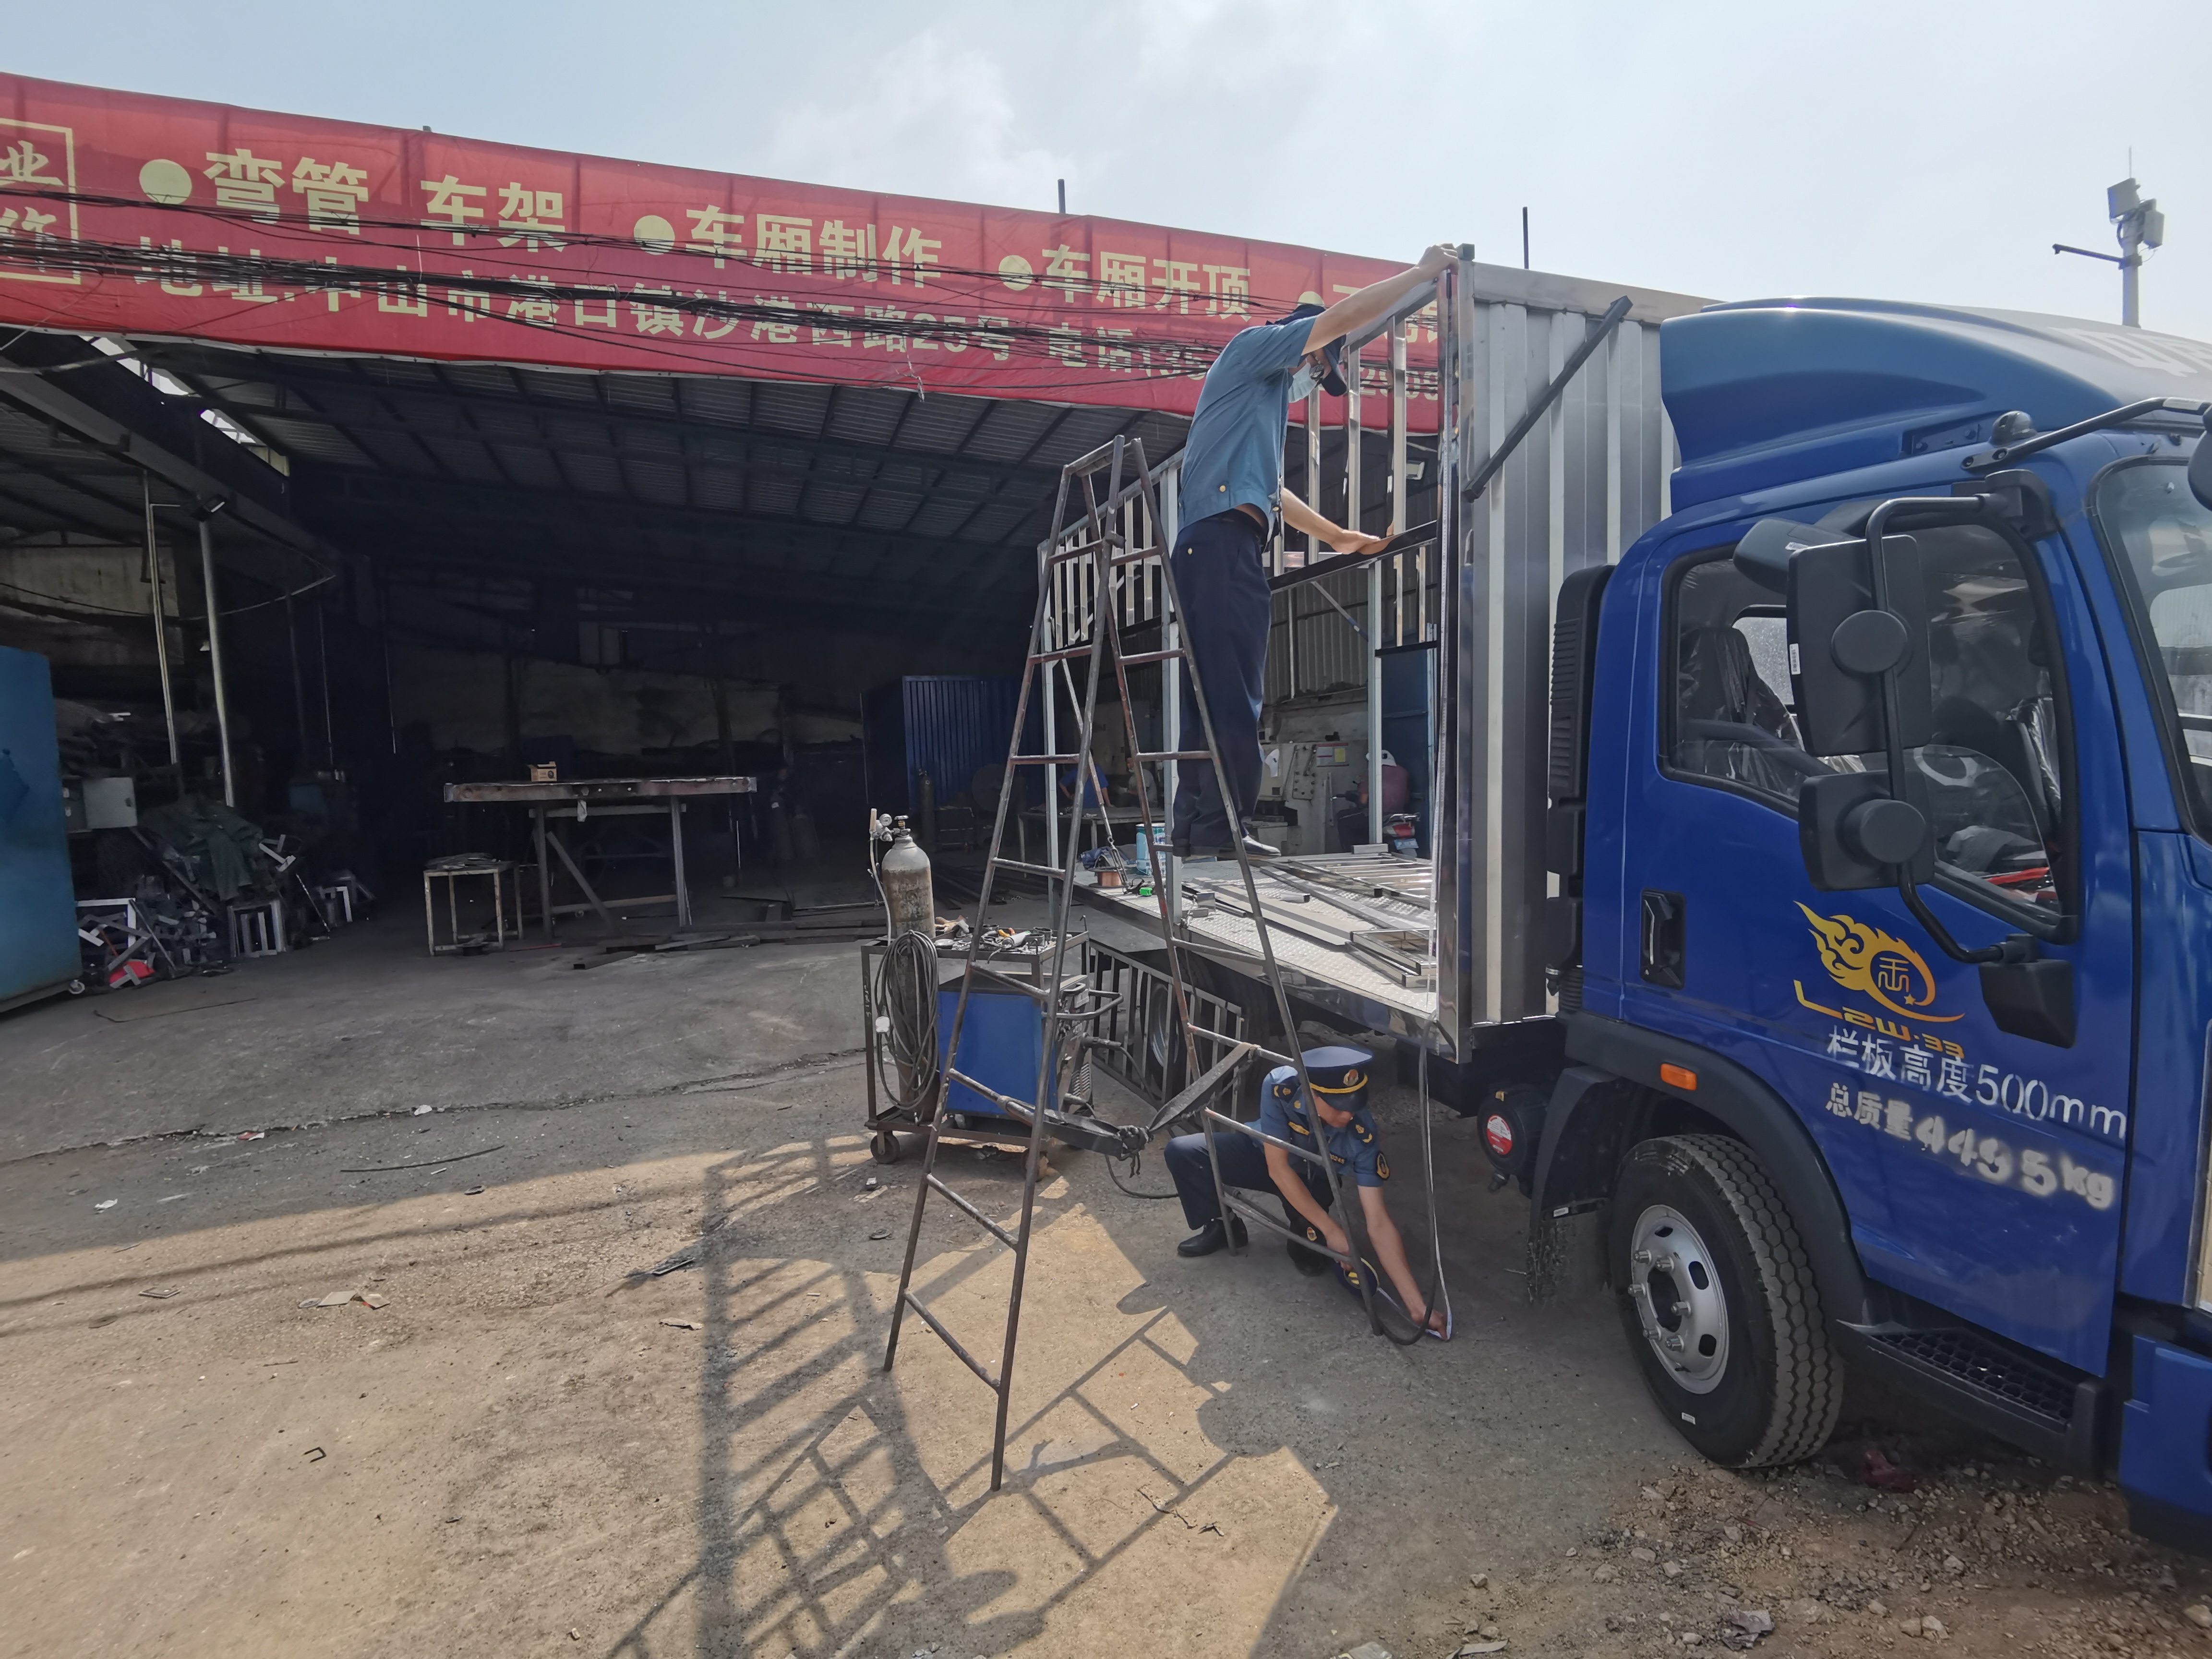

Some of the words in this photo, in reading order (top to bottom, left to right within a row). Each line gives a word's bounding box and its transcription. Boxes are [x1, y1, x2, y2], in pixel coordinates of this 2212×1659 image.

[203, 148, 369, 235] 弯管
[421, 175, 567, 253] 车架
[685, 204, 942, 289] 车厢制作
[1042, 243, 1251, 323] 车厢开顶
